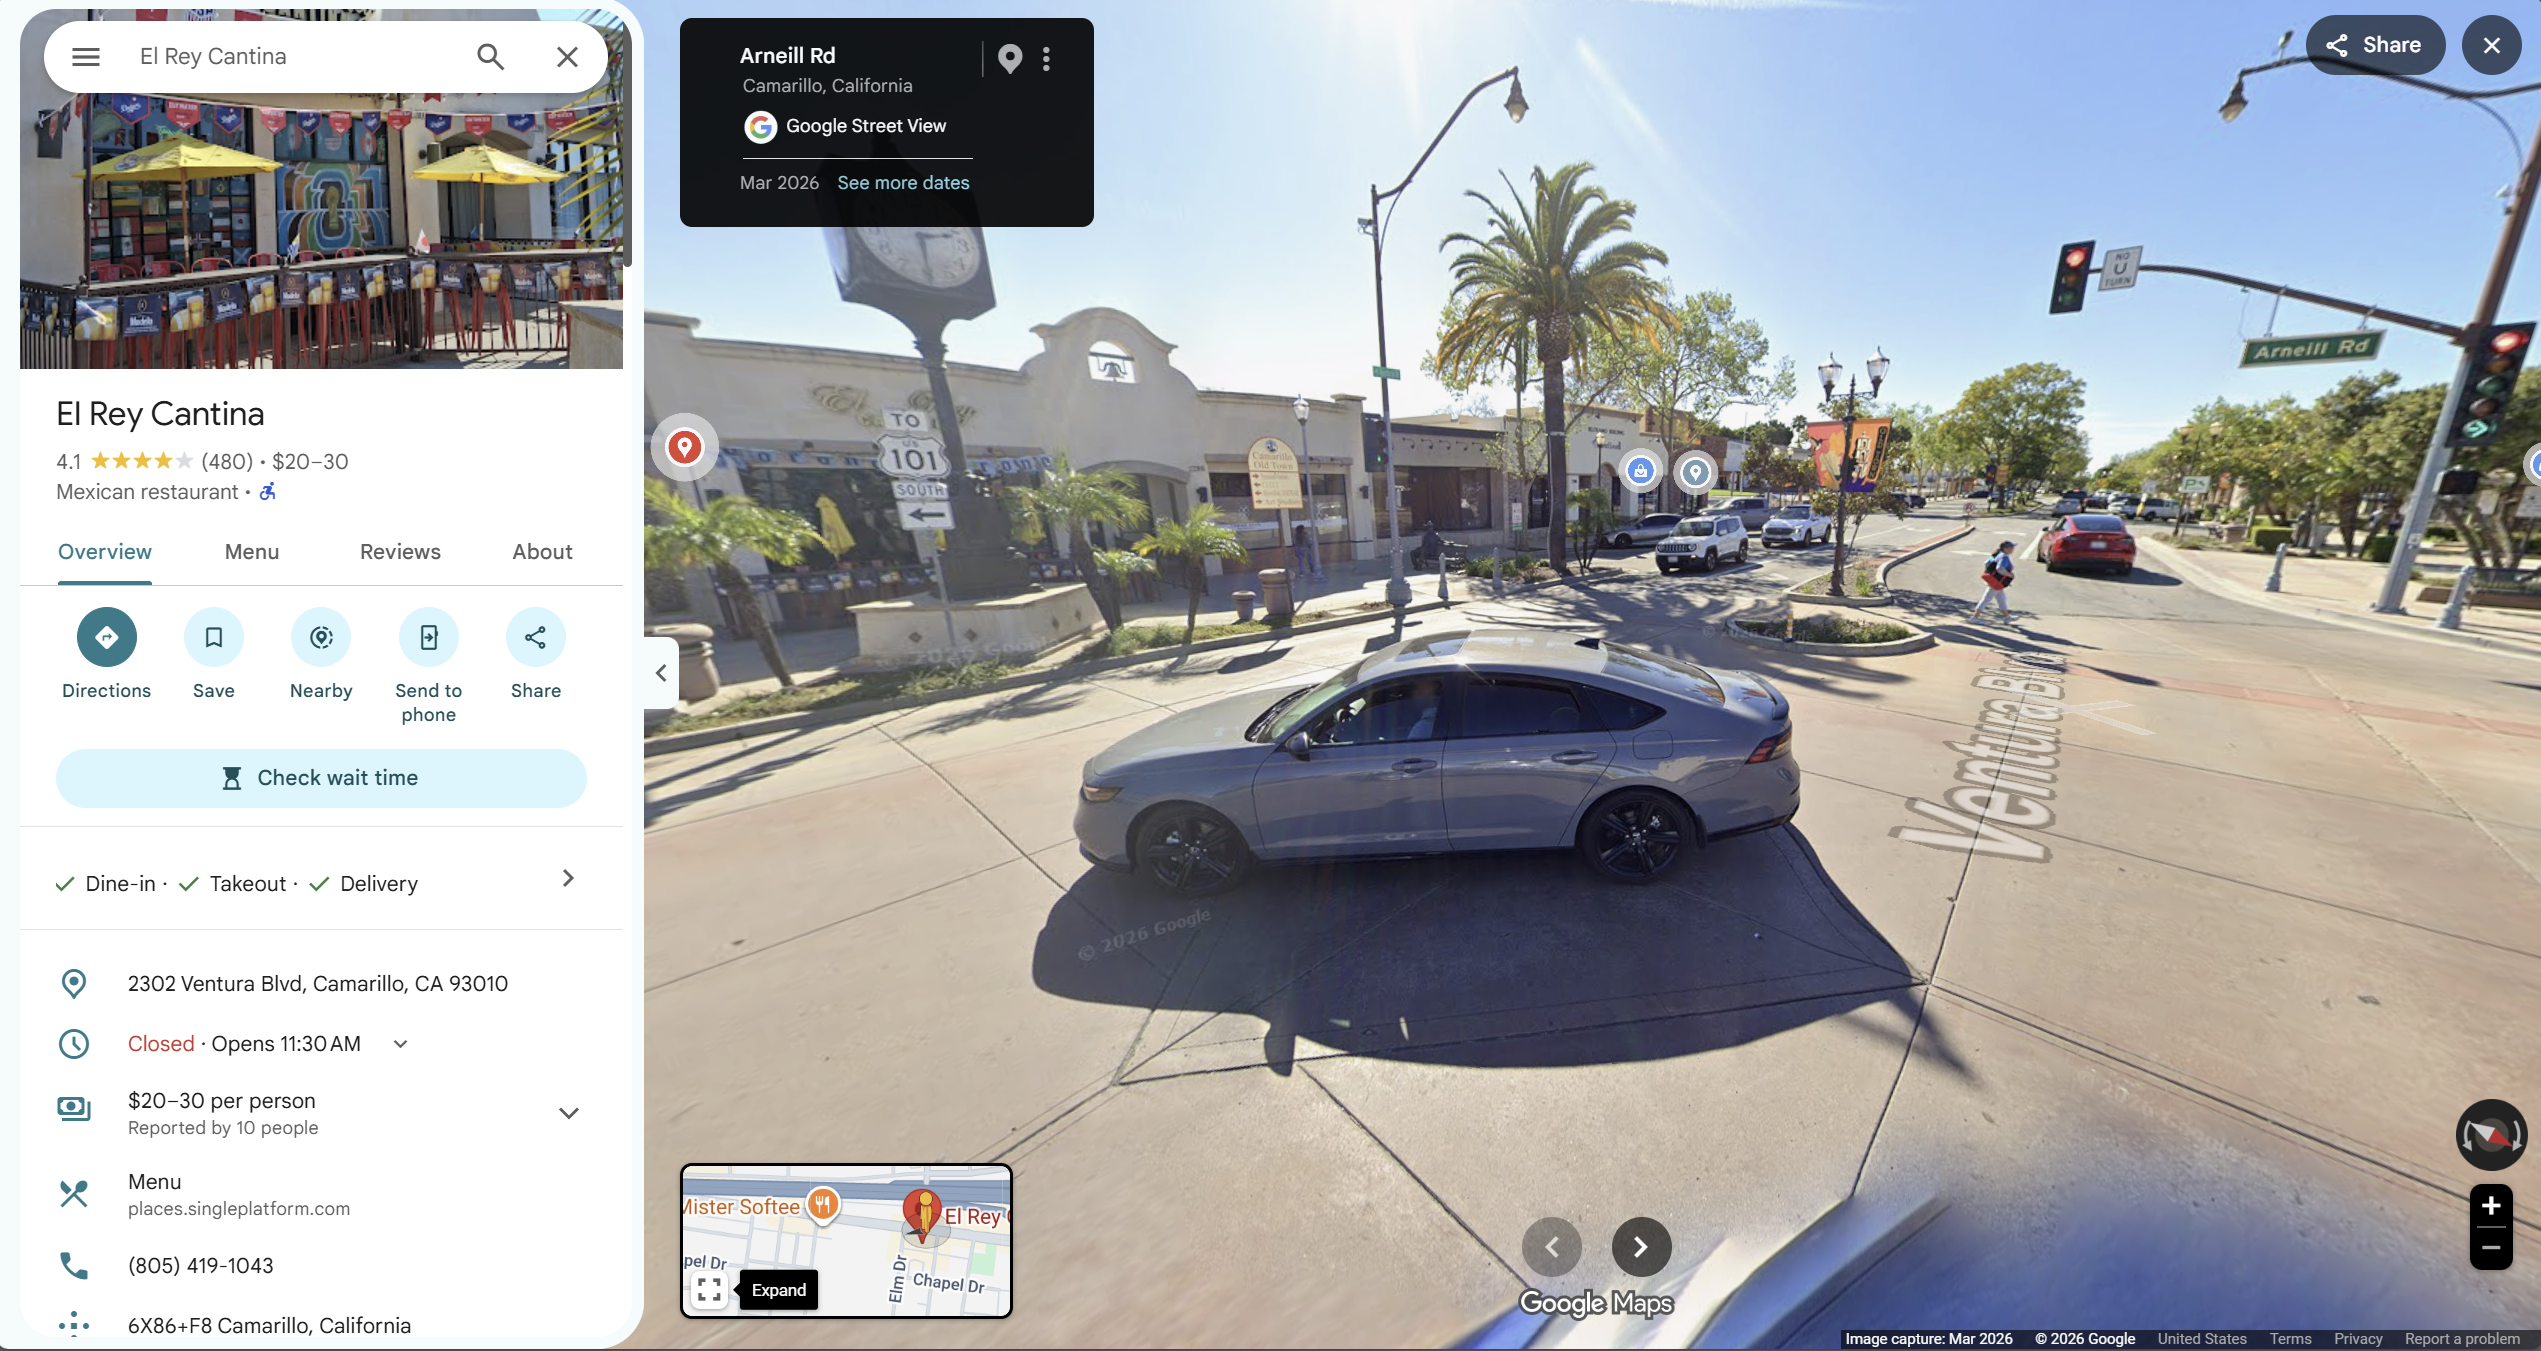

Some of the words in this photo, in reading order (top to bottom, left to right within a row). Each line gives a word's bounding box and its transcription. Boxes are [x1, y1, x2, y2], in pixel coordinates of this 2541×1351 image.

[2115, 251, 2131, 261] NO
[2113, 262, 2128, 276] U
[2105, 276, 2132, 287] TURN
[2253, 341, 2330, 360] Arneill
[2336, 338, 2372, 355] Rd
[891, 412, 921, 428] TO
[891, 449, 938, 472] 101
[1252, 451, 1293, 461] Camarillo
[1253, 461, 1270, 470] Old
[1271, 462, 1294, 470] Town
[896, 483, 945, 497] SOUTH
[2184, 479, 2197, 490] P
